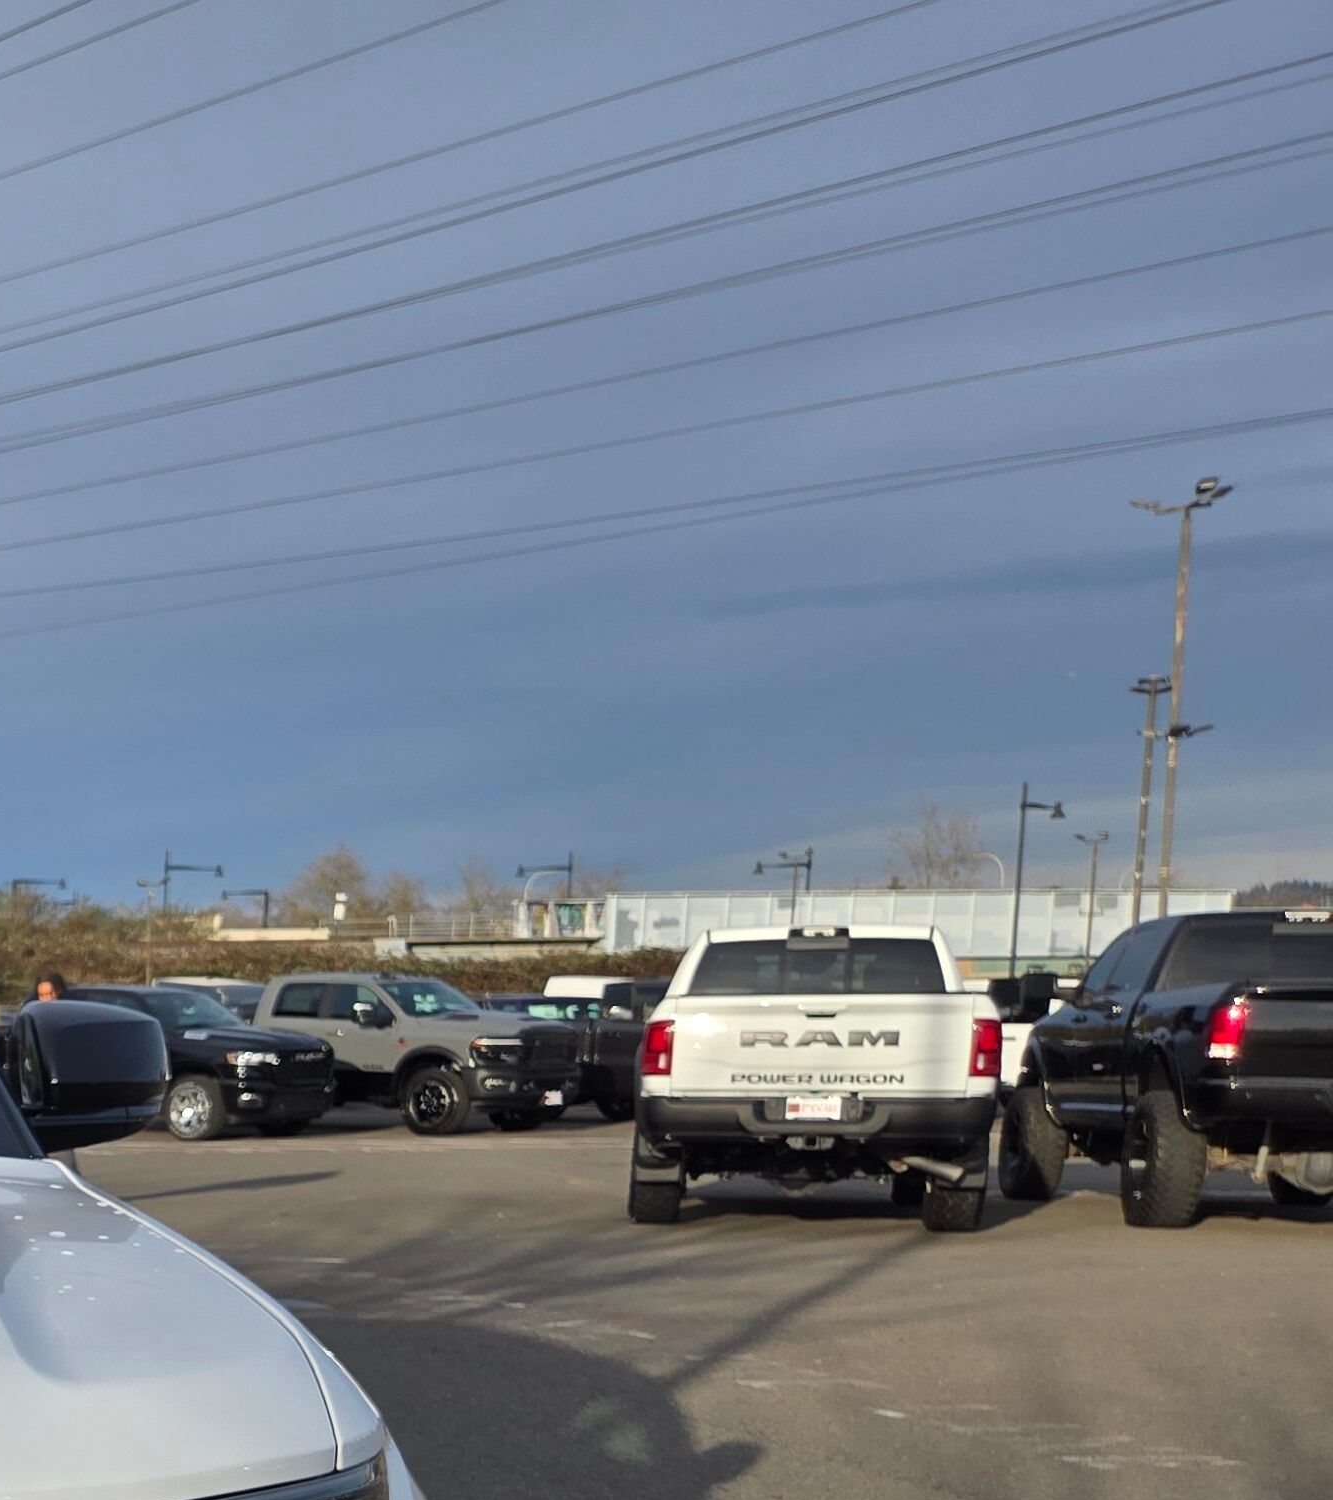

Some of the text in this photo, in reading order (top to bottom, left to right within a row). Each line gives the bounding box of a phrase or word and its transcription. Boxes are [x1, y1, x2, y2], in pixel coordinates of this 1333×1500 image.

[740, 1030, 900, 1048] RAM
[731, 1073, 905, 1084] POWER WAGON
